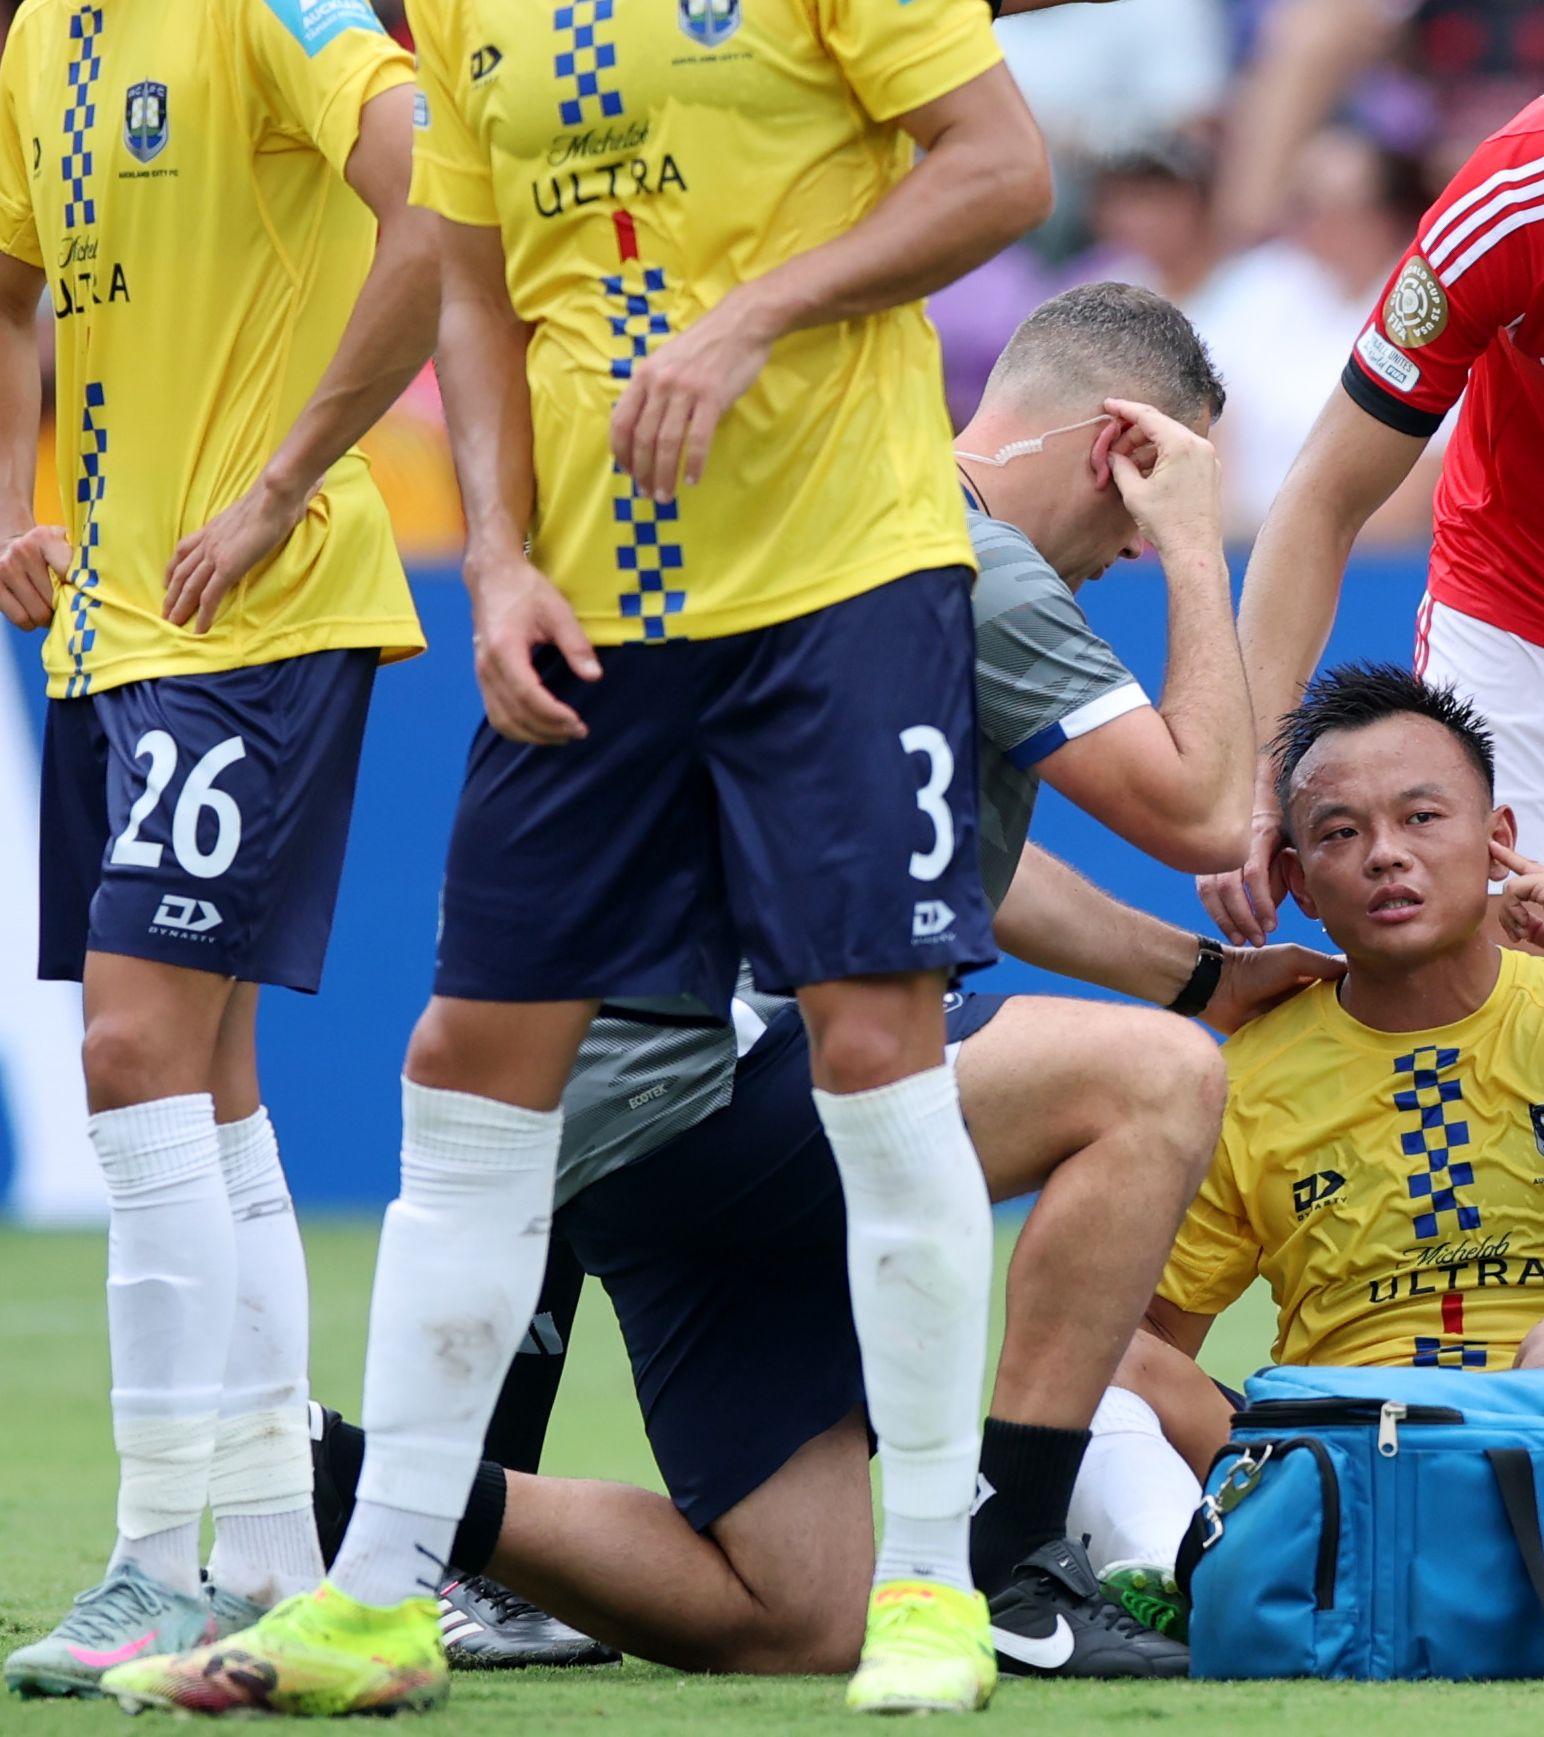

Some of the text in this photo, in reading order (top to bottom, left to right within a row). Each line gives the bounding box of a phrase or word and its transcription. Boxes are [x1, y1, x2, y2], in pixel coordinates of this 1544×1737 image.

[532, 154, 688, 218] ULTRA
[1426, 280, 1441, 304] CUP
[1412, 321, 1435, 337] USA
[110, 729, 246, 879] 26
[899, 724, 955, 881] 3
[148, 926, 215, 943] DYNASTY
[628, 1083, 668, 1110] ECOTEK
[1297, 1196, 1347, 1221] DYASTY
[1403, 1231, 1512, 1266] Michelob
